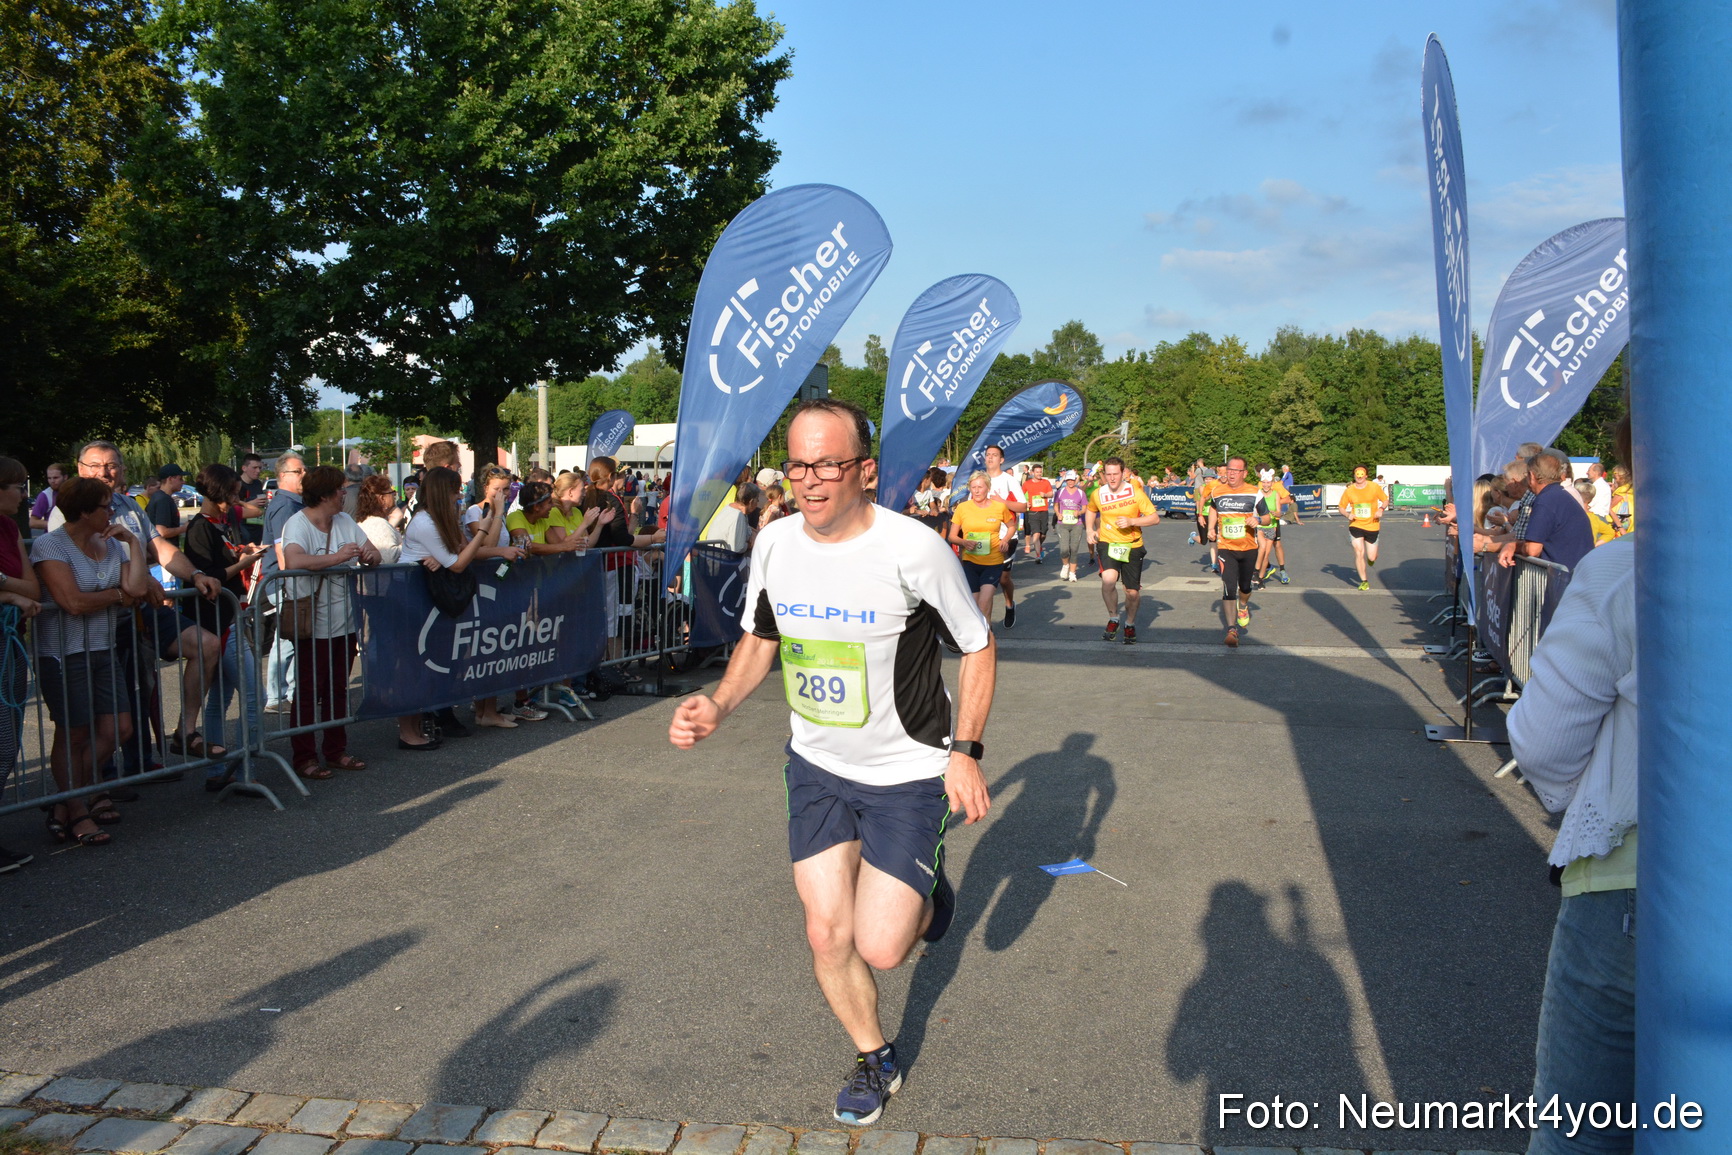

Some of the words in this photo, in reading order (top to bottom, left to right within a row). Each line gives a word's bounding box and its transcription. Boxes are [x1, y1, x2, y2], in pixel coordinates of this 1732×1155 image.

[736, 221, 848, 369] Fischer
[775, 251, 861, 369] AUTOMOBILE
[1525, 247, 1628, 387] Fischer
[1561, 286, 1629, 385] AUTOMOBI
[918, 297, 991, 403] Fischer
[944, 317, 1001, 402] AUTOMOBILE
[598, 417, 625, 453] Fischer
[971, 415, 1052, 466] Frchmann
[1023, 430, 1043, 445] Druck
[1056, 410, 1080, 428] Medien
[1102, 504, 1117, 512] MAX
[1119, 499, 1137, 508] BÖGL
[1397, 488, 1416, 498] AOK
[1224, 525, 1243, 533] 1637
[776, 602, 876, 624] DELPHI
[451, 612, 565, 661] Fischer
[463, 648, 556, 682] AUTOMOBILE
[796, 671, 846, 704] 289
